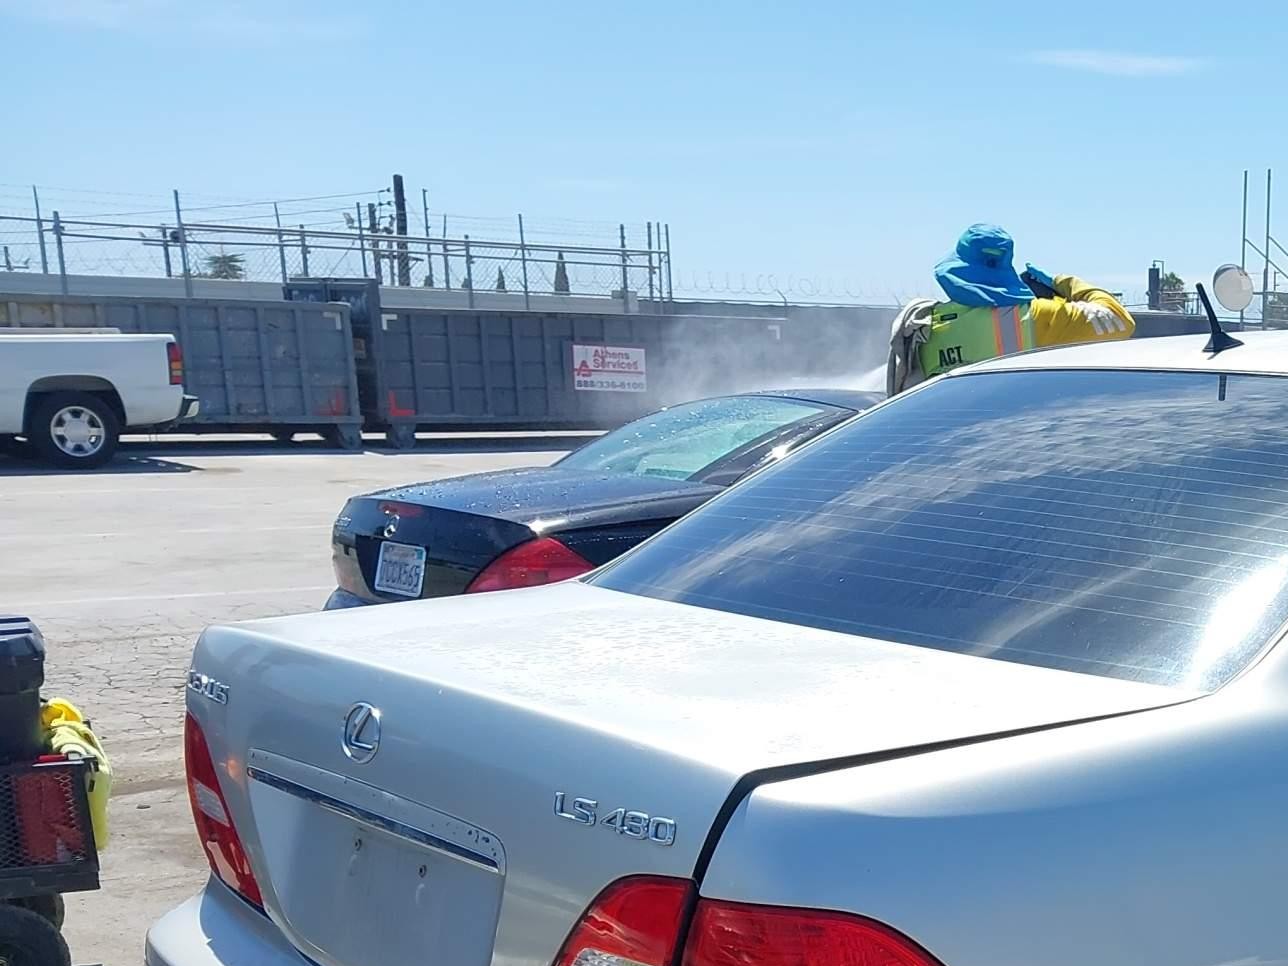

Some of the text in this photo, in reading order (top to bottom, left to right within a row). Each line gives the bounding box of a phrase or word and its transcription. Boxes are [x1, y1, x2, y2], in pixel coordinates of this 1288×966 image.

[592, 347, 630, 360] Athens
[939, 345, 962, 367] ACT
[593, 358, 639, 369] Services
[553, 791, 677, 846] LS 430
